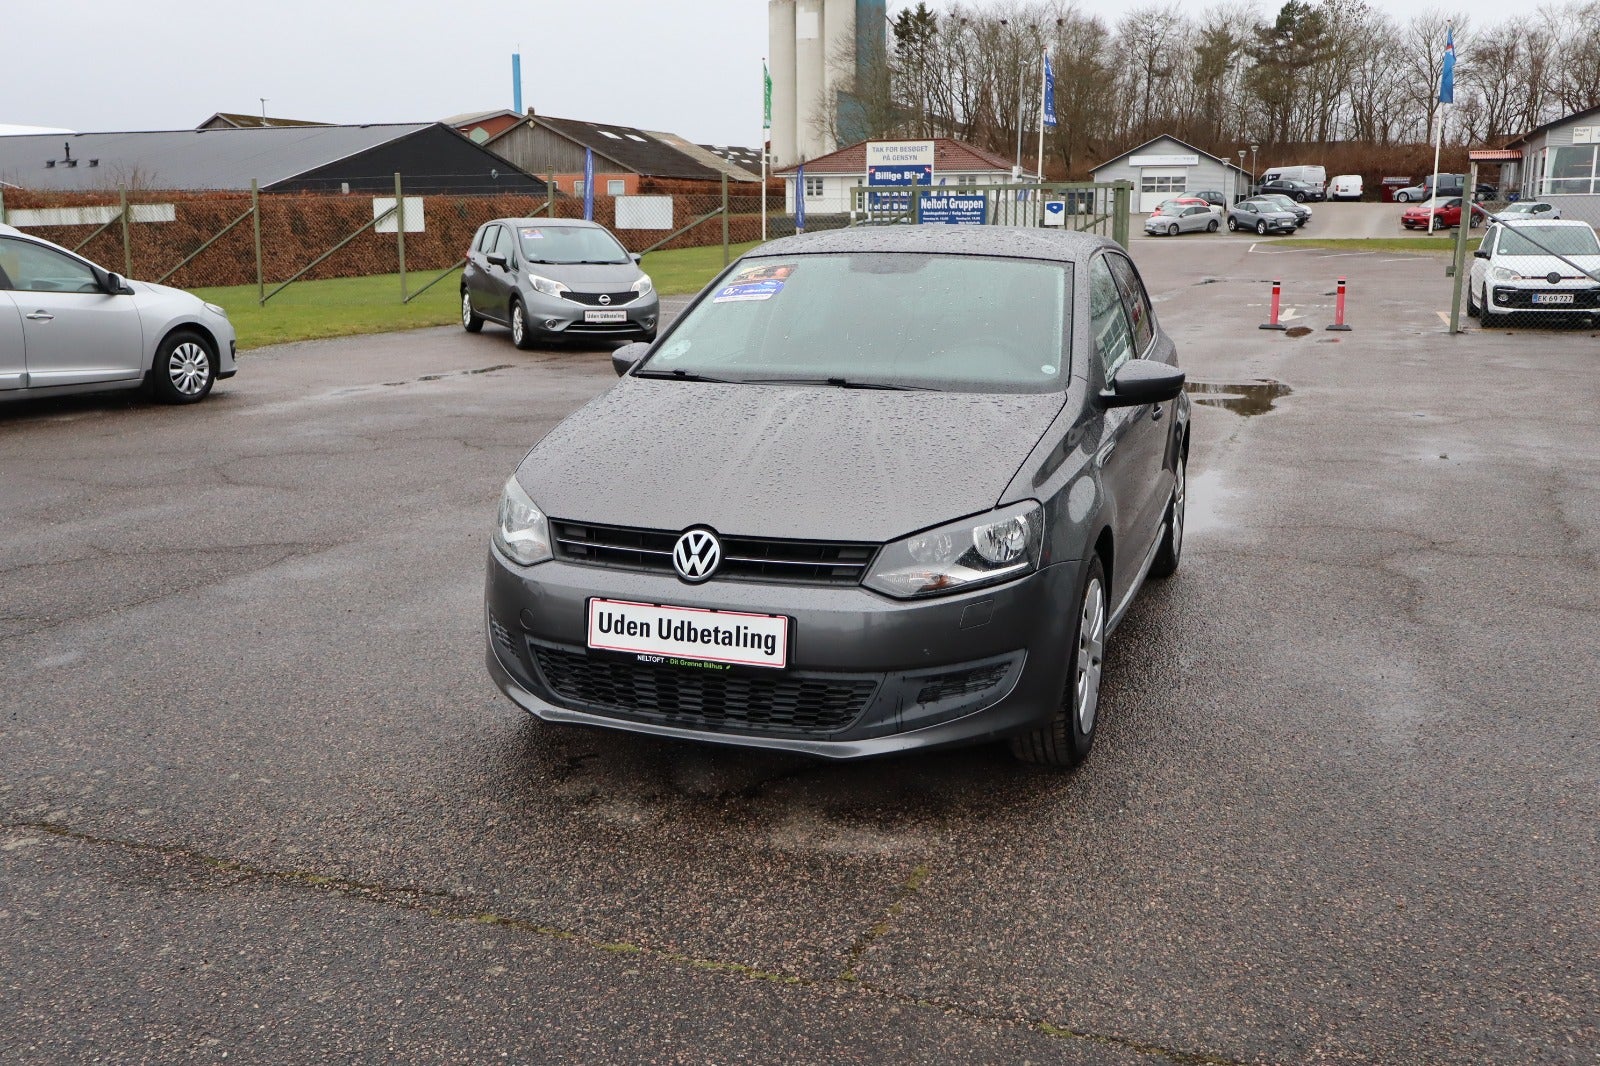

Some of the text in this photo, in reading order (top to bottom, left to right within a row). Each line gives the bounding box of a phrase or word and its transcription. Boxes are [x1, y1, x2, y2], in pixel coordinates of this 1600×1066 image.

[875, 172, 902, 181] Billige
[921, 198, 984, 211] Neltoft Gruppen
[598, 612, 776, 656] Uden Udbetaling
[637, 655, 665, 663] NELTOFT
